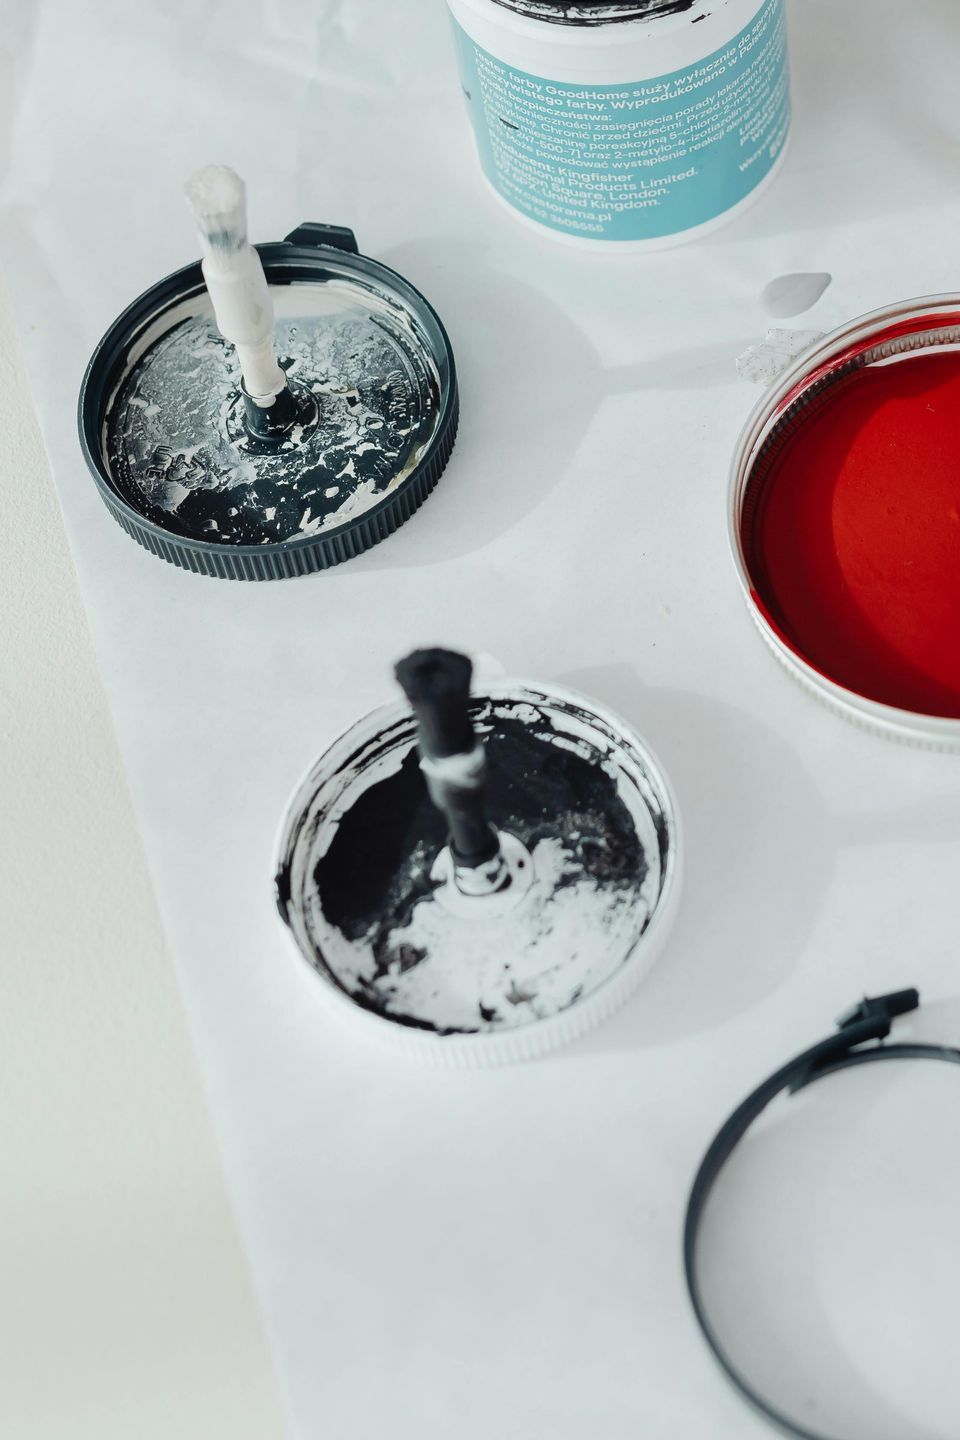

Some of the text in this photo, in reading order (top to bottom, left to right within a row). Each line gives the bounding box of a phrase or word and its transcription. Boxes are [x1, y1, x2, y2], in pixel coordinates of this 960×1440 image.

[508, 71, 541, 92] farby
[545, 85, 628, 99] GoodHome
[632, 82, 670, 97] służy
[674, 47, 735, 85] wyłącznie
[737, 33, 750, 48] do
[566, 99, 606, 111] farby.
[610, 66, 725, 109] Wyprodukowano
[727, 55, 737, 67] w
[739, 22, 767, 58] Polsce
[508, 91, 611, 120] bezpieczeństwa:
[514, 102, 591, 129] konieczności
[594, 114, 672, 130] zasięgnięcia
[674, 95, 715, 119] porady
[716, 67, 750, 97] lekarza
[540, 123, 589, 139] Chronić
[592, 131, 630, 141] przed
[632, 121, 685, 137] dziećmi.
[686, 100, 720, 123] Przed
[520, 124, 586, 149] mieszaninę
[589, 136, 666, 150] poreakcyjną
[535, 149, 608, 168] powodować
[611, 149, 686, 169] wystąpienie
[688, 129, 724, 152] reakcji
[582, 151, 610, 159] oraz
[557, 166, 633, 182] Kingfisher
[567, 178, 636, 191] Products
[541, 187, 587, 207] United
